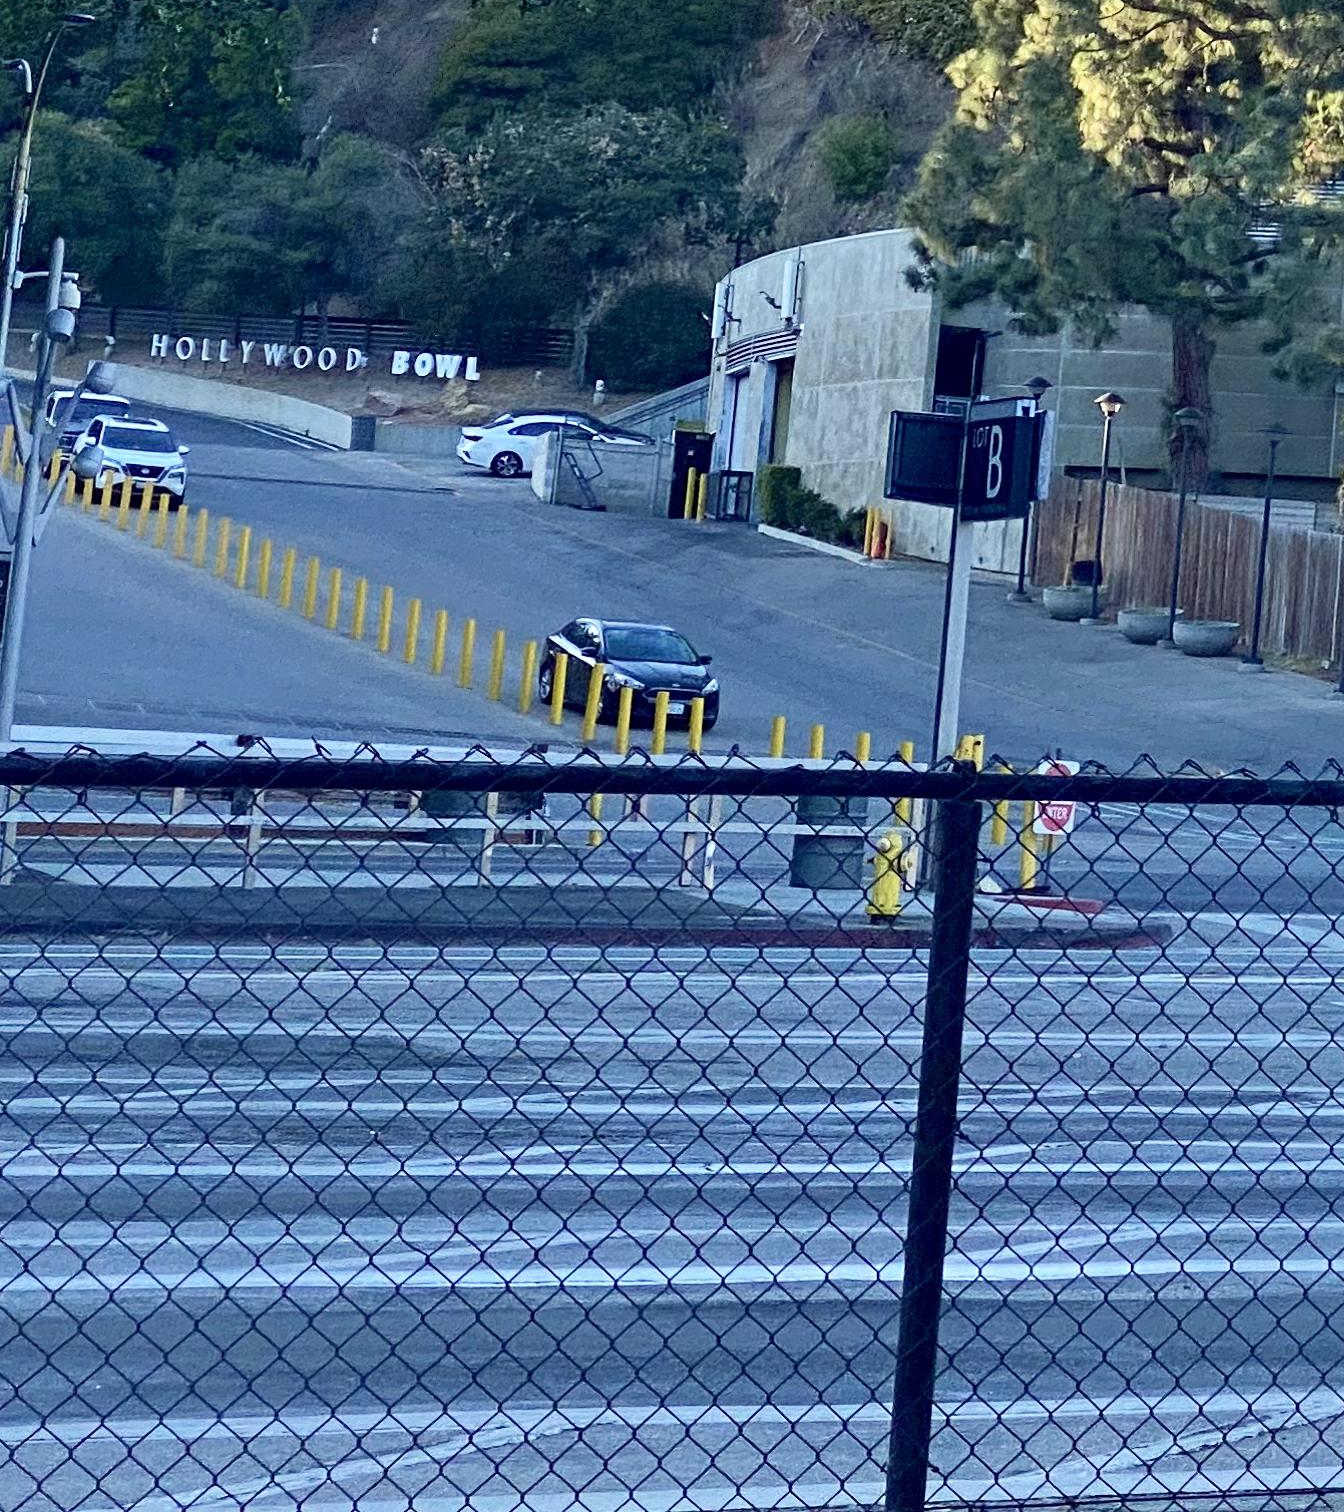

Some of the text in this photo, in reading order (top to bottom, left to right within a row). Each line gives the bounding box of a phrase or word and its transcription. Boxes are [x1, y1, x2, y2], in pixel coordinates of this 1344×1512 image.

[151, 333, 480, 381] HOLLYWOOD BOWL
[986, 425, 1003, 499] B
